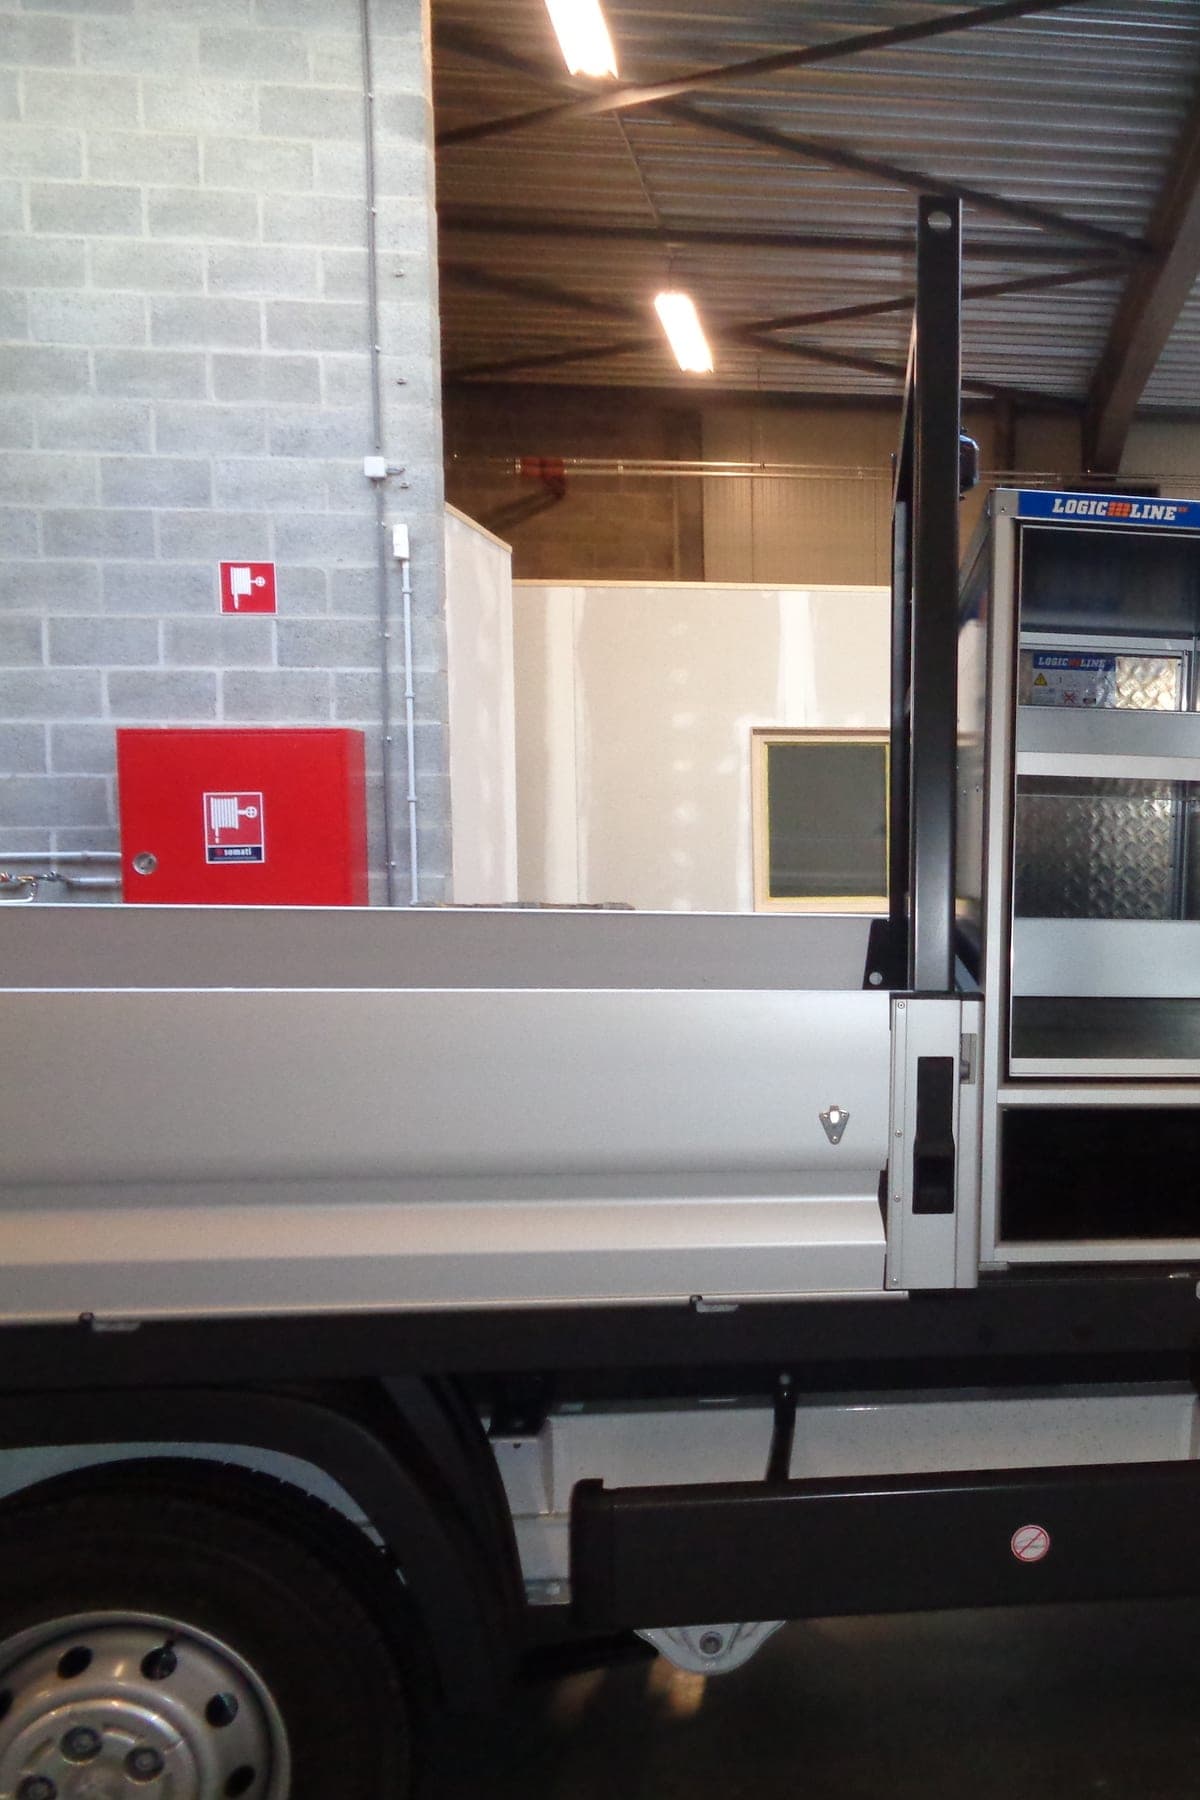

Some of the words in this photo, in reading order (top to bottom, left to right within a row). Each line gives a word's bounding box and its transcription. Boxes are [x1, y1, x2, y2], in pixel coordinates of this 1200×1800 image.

[1052, 498, 1108, 517] LOGIC
[1129, 502, 1178, 522] LINE
[1038, 656, 1069, 667] LOGIC
